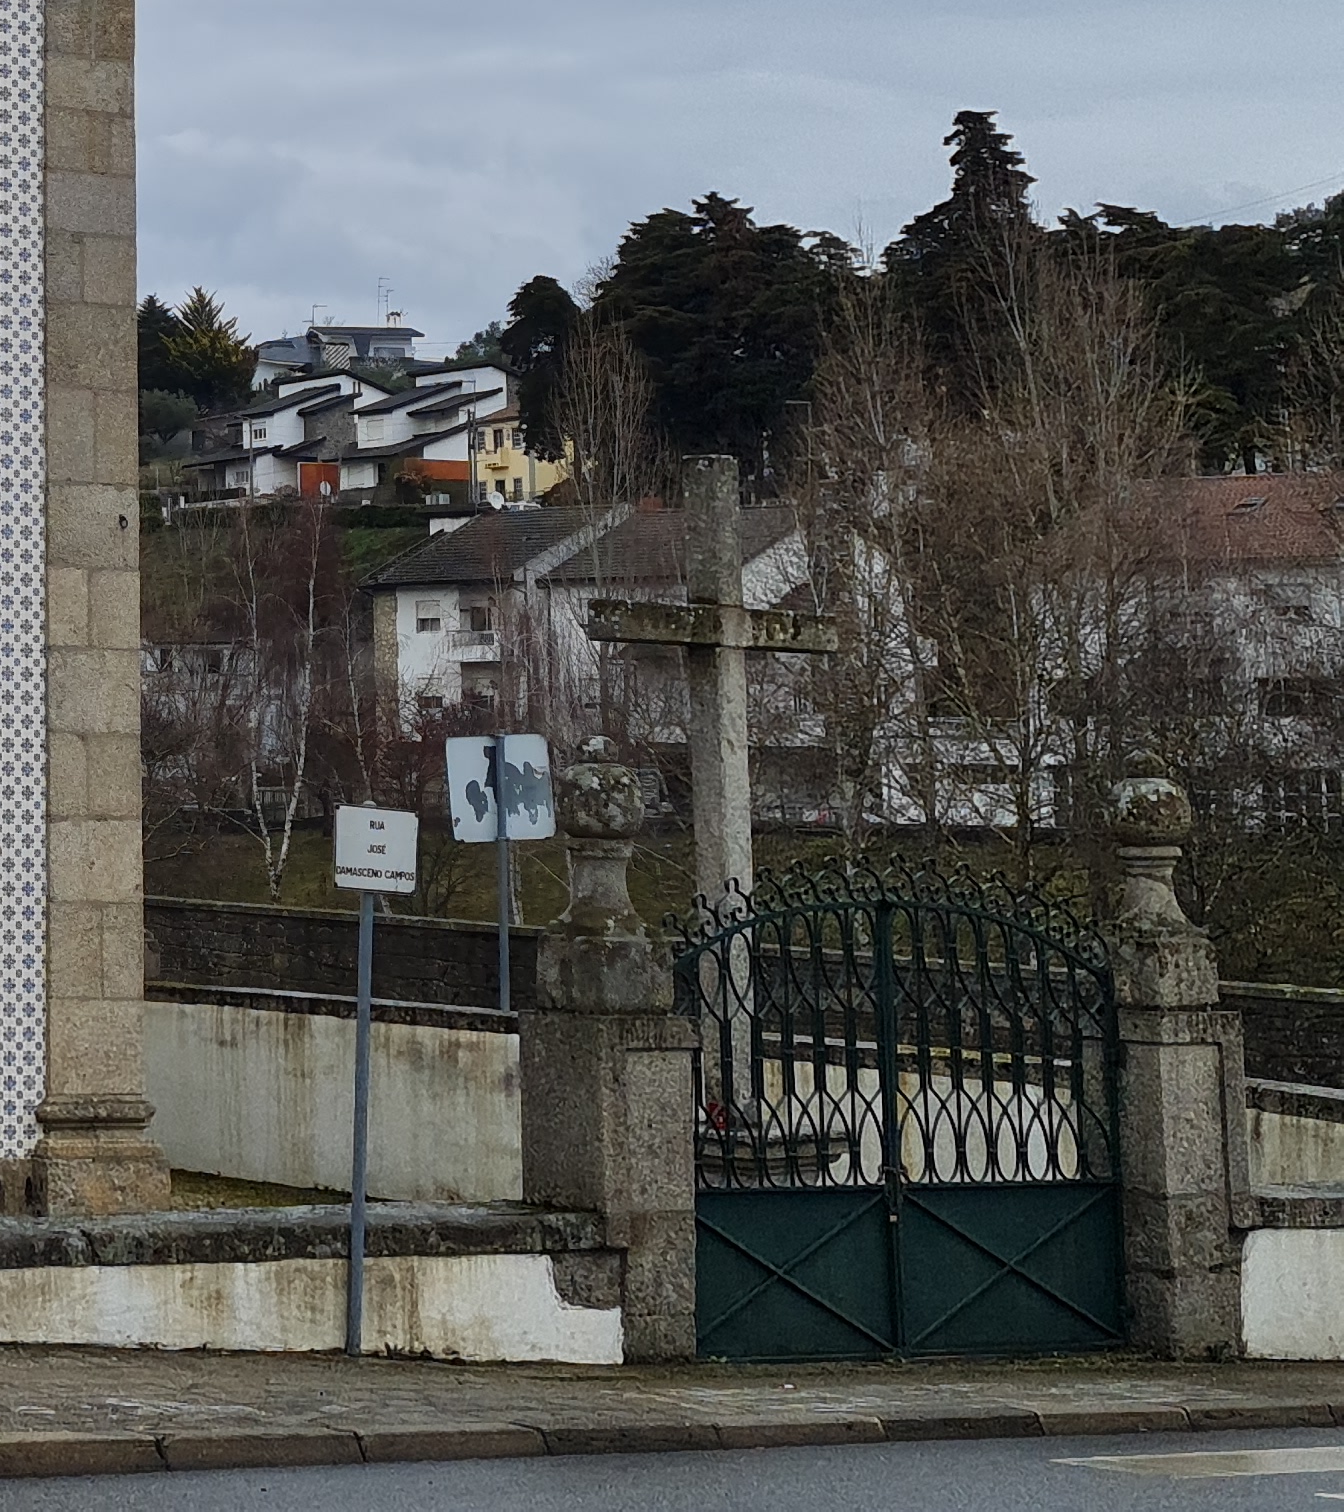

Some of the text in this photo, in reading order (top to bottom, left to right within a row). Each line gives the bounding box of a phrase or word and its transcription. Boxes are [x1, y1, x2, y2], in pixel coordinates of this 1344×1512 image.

[369, 820, 385, 830] RUA
[367, 843, 386, 855] JOSÉ
[336, 866, 415, 881] DAMASCENO CAMPOS
